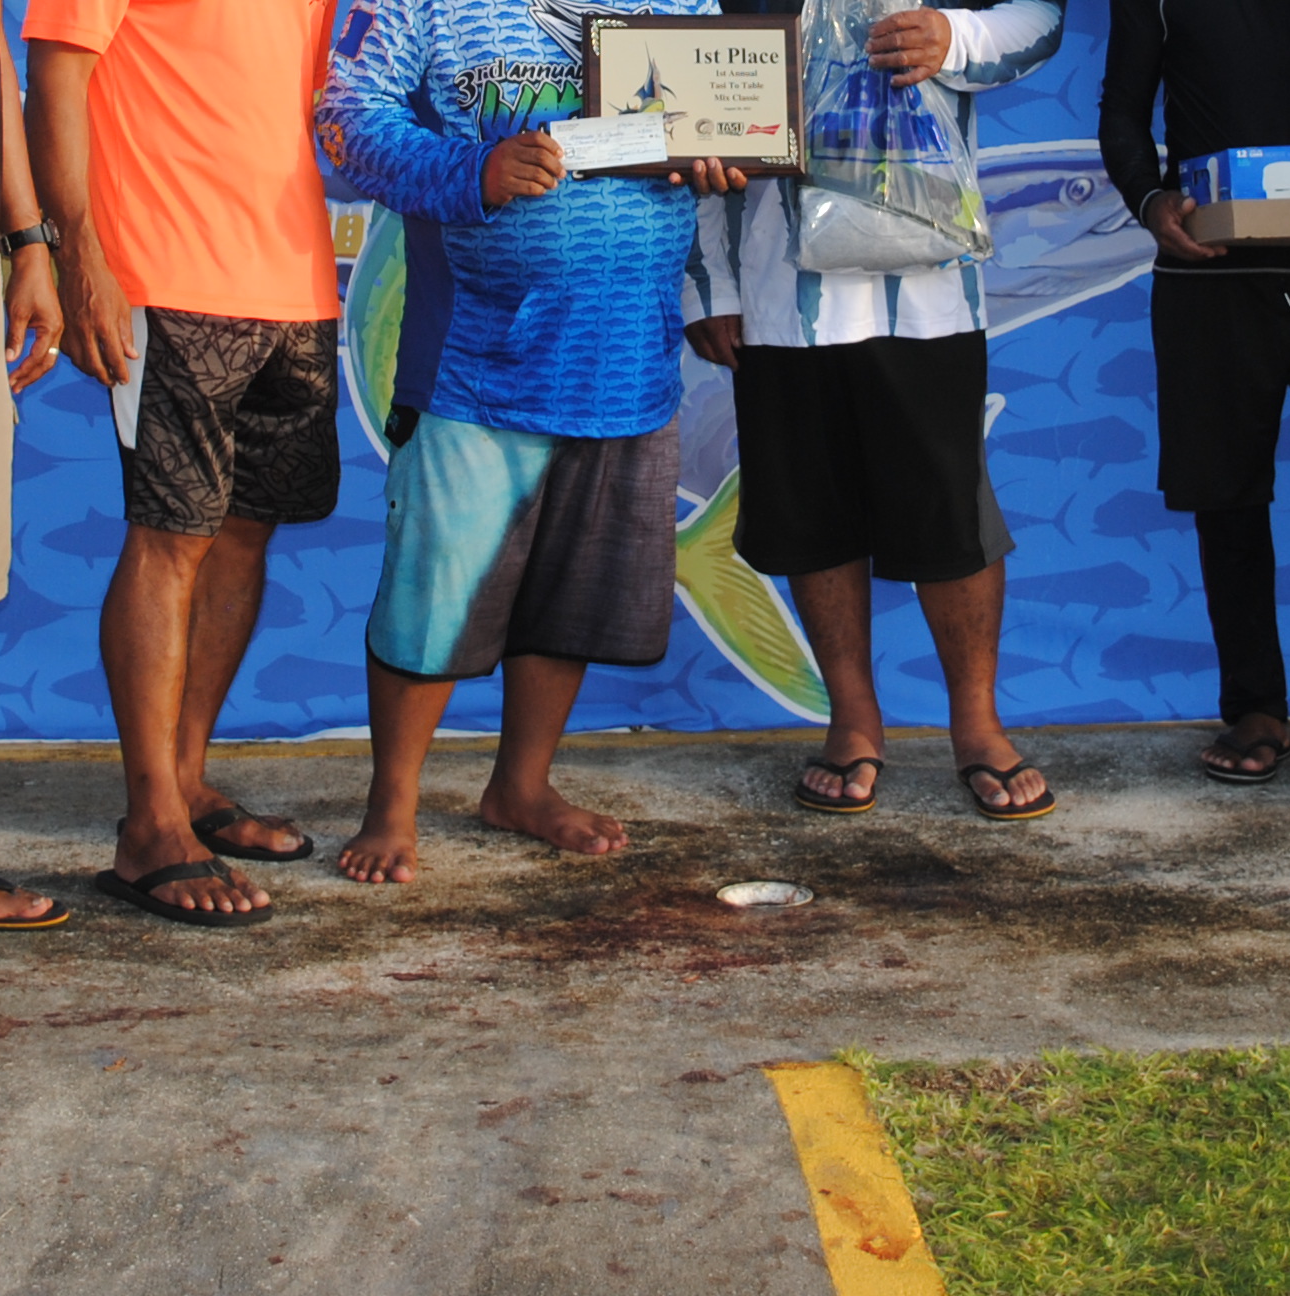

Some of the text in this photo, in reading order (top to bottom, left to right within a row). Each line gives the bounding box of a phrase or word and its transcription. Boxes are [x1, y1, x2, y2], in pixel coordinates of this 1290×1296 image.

[695, 48, 779, 64] 1st Place
[454, 58, 506, 109] 3rd
